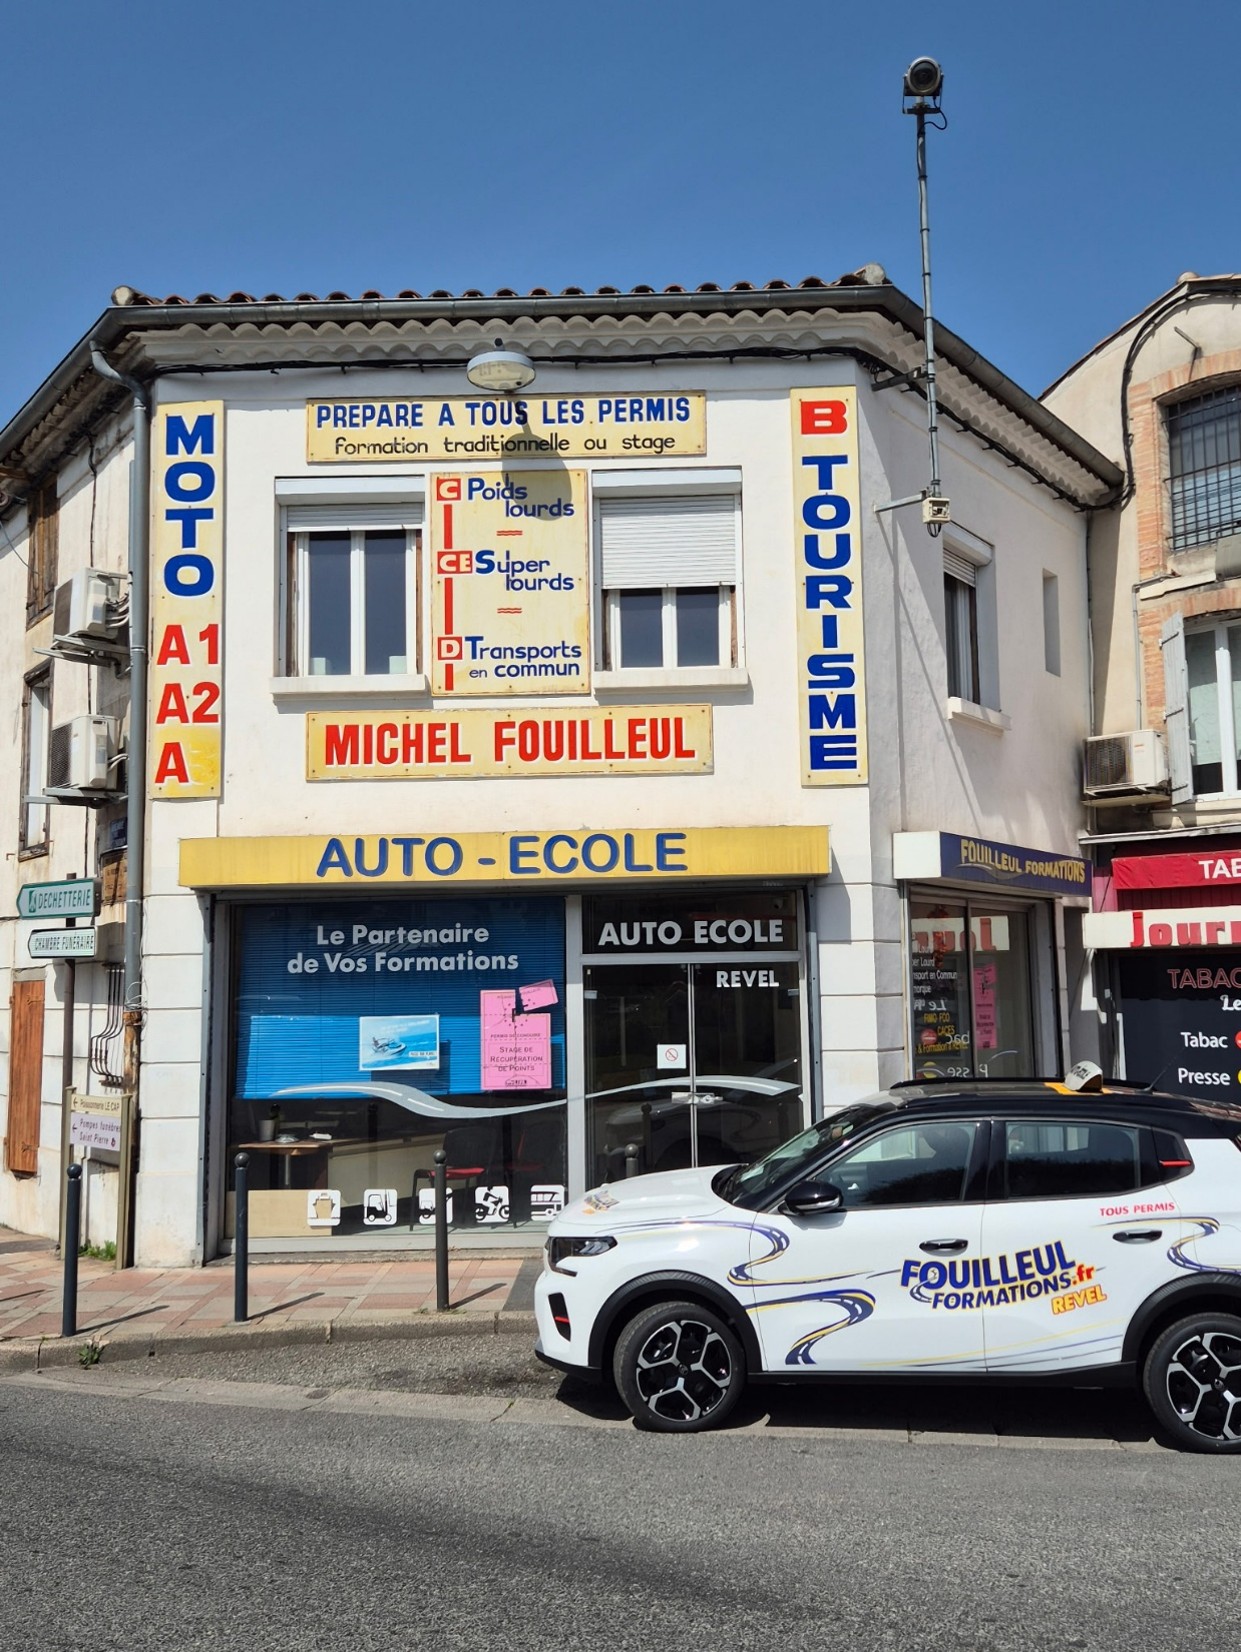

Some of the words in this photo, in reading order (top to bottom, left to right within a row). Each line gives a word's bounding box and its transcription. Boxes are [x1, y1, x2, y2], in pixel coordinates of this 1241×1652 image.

[317, 403, 423, 428] PREPARE
[438, 403, 455, 426] A
[465, 401, 528, 426] TOUS
[542, 399, 585, 425] LES
[599, 397, 690, 423] PERMIS
[800, 400, 848, 435] B
[335, 437, 428, 455] formation
[444, 432, 570, 452] traditionnelle
[584, 438, 607, 450] ou
[622, 434, 675, 454] stage
[438, 480, 459, 498] C
[468, 473, 527, 500] Poids
[163, 414, 216, 597] MOTO
[506, 498, 574, 517] lourds
[439, 553, 472, 573] CE
[475, 550, 550, 577] Super
[506, 573, 574, 591] lourds
[801, 454, 858, 770] TOURISME
[156, 624, 220, 666] A1
[440, 639, 460, 658] D
[465, 636, 581, 662] Transports
[469, 668, 488, 679] en
[494, 662, 579, 678] commun
[155, 681, 220, 725] A2
[325, 722, 471, 766] MICHEL
[494, 717, 696, 762] FOUILLEUL
[154, 741, 189, 784] A
[316, 837, 464, 877] AUTO
[508, 833, 688, 874] ECOLE
[960, 838, 1022, 873] FOUILLEUL
[1025, 860, 1086, 883] FORMATIONS
[38, 888, 91, 909] DECHETTERIE
[34, 936, 60, 951] CHAMBRE
[316, 925, 345, 945] Le
[352, 923, 489, 944] Partenaire
[598, 921, 682, 945] AUTO
[694, 919, 783, 943] ECOLE
[287, 952, 319, 973] de
[324, 952, 367, 972] Vos
[375, 950, 519, 972] Formations
[716, 970, 779, 988] REVEL
[1167, 967, 1241, 989] TABAC
[1180, 1031, 1228, 1048] Tabac
[1178, 1067, 1231, 1085] Presse
[1100, 1206, 1130, 1216] TOUS
[1133, 1202, 1176, 1214] PERMIS
[900, 1240, 1076, 1288] FOUILLEUL
[1051, 1284, 1108, 1315] REVEL
